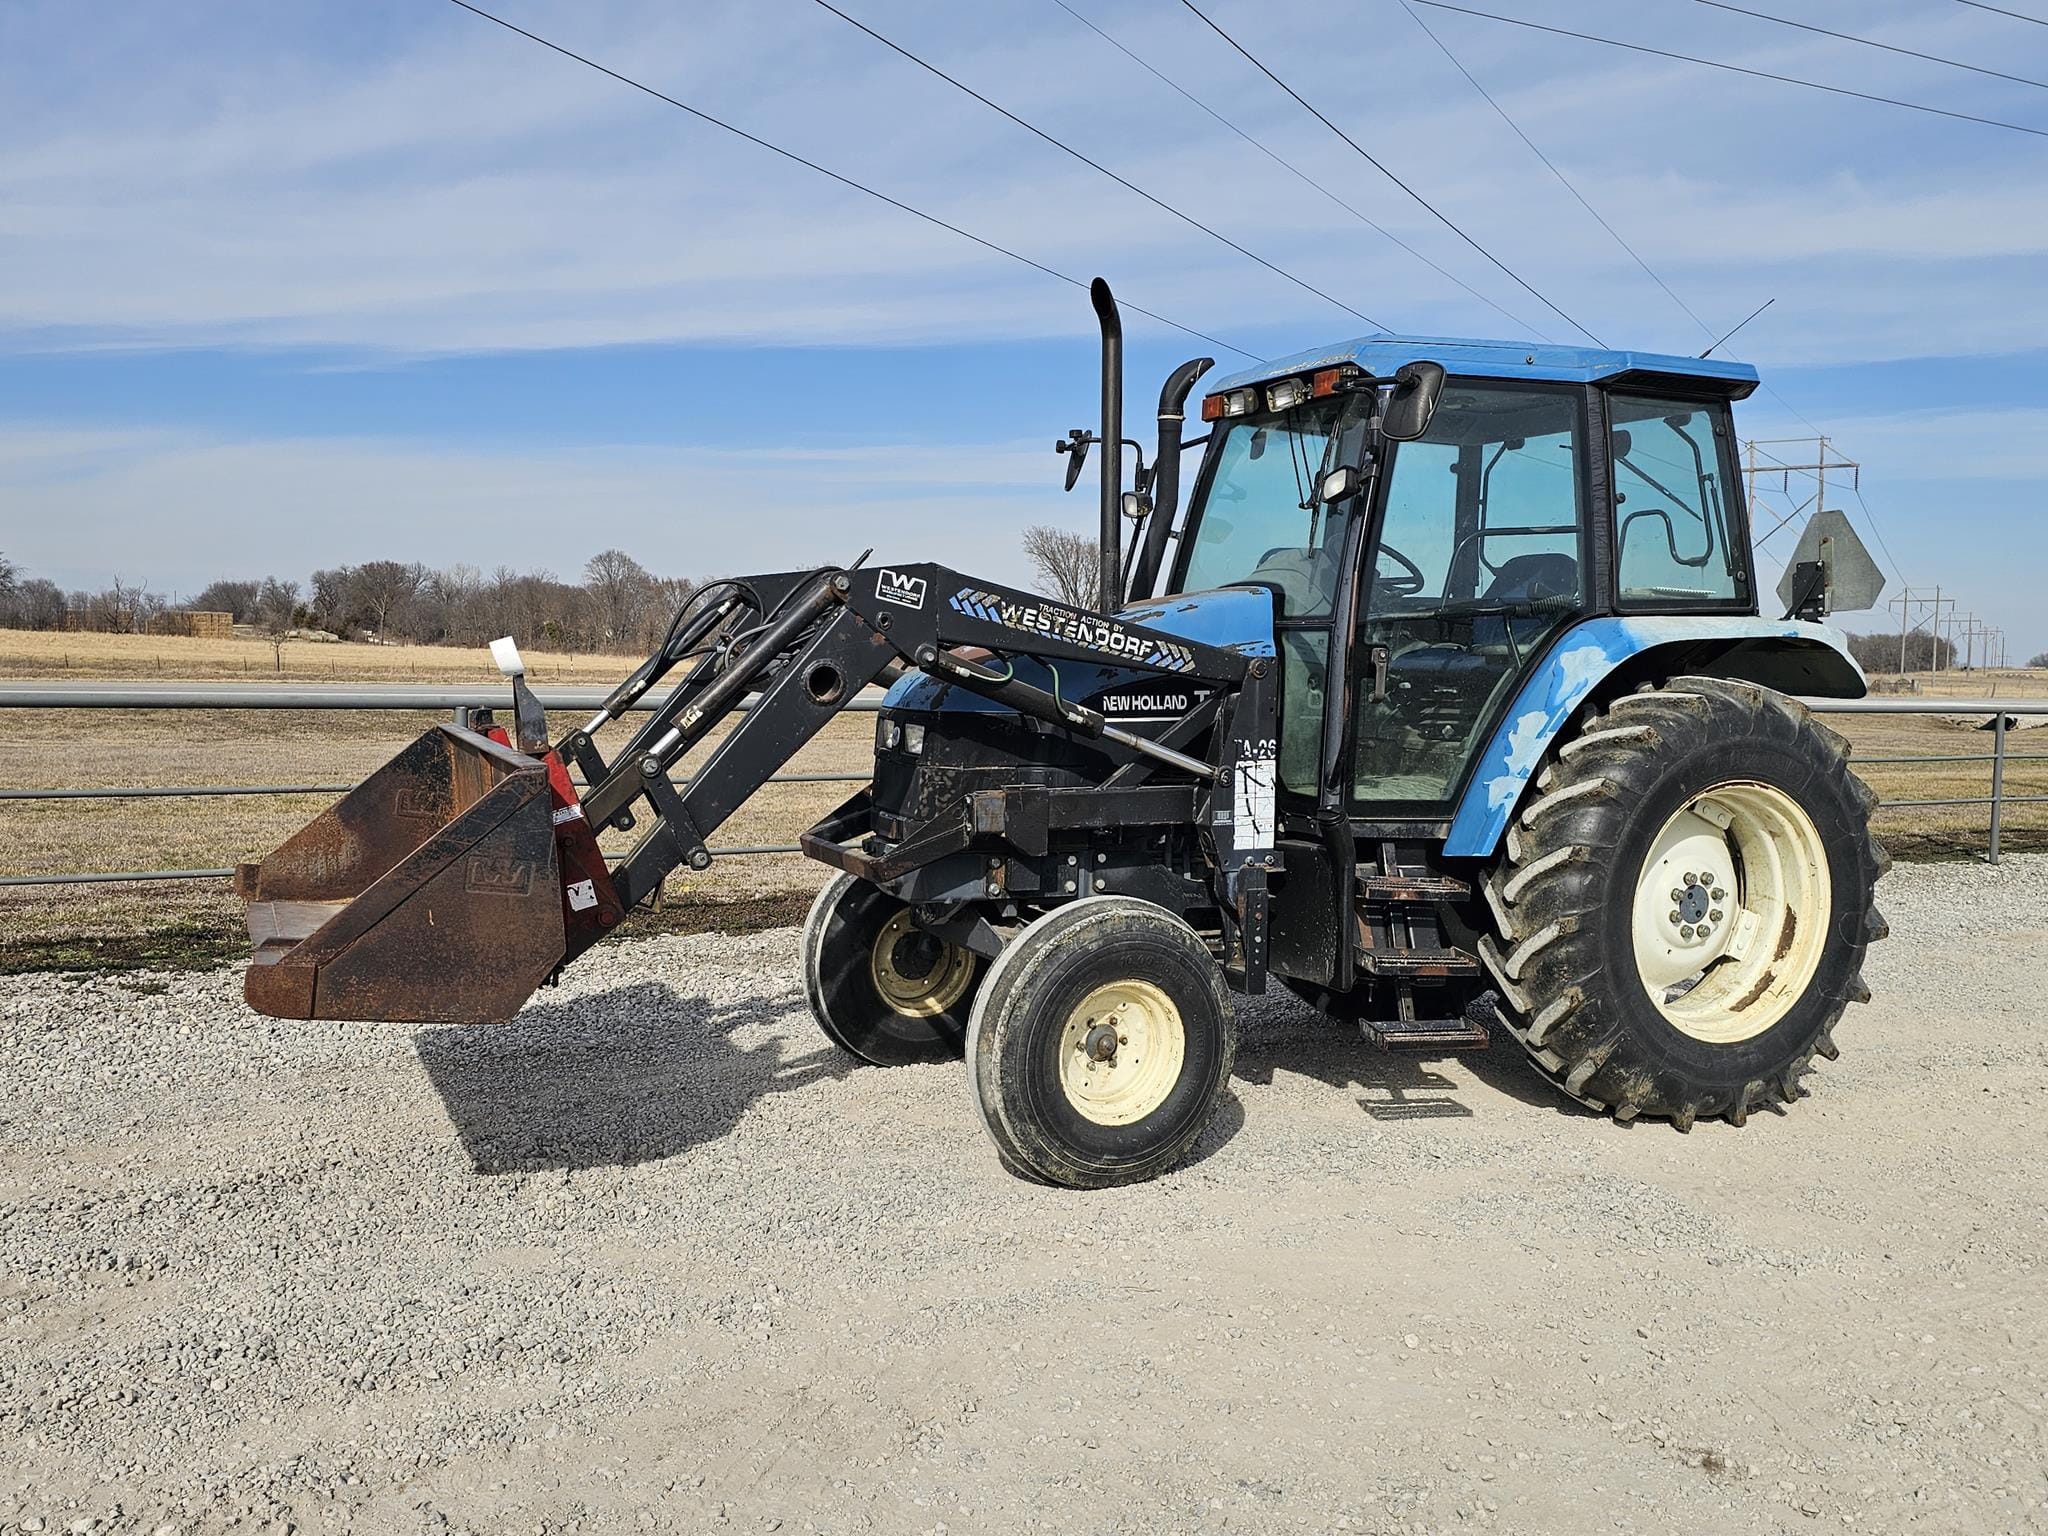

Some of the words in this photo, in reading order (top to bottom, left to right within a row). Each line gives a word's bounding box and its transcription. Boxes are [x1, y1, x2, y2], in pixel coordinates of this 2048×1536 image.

[1000, 600, 1154, 657] WESTENDORF
[1038, 603, 1077, 620] TRACTION
[1080, 615, 1110, 628] ACTION
[1113, 623, 1125, 632] BY
[1103, 695, 1130, 711] NEW
[1132, 694, 1187, 710] HOLLAND
